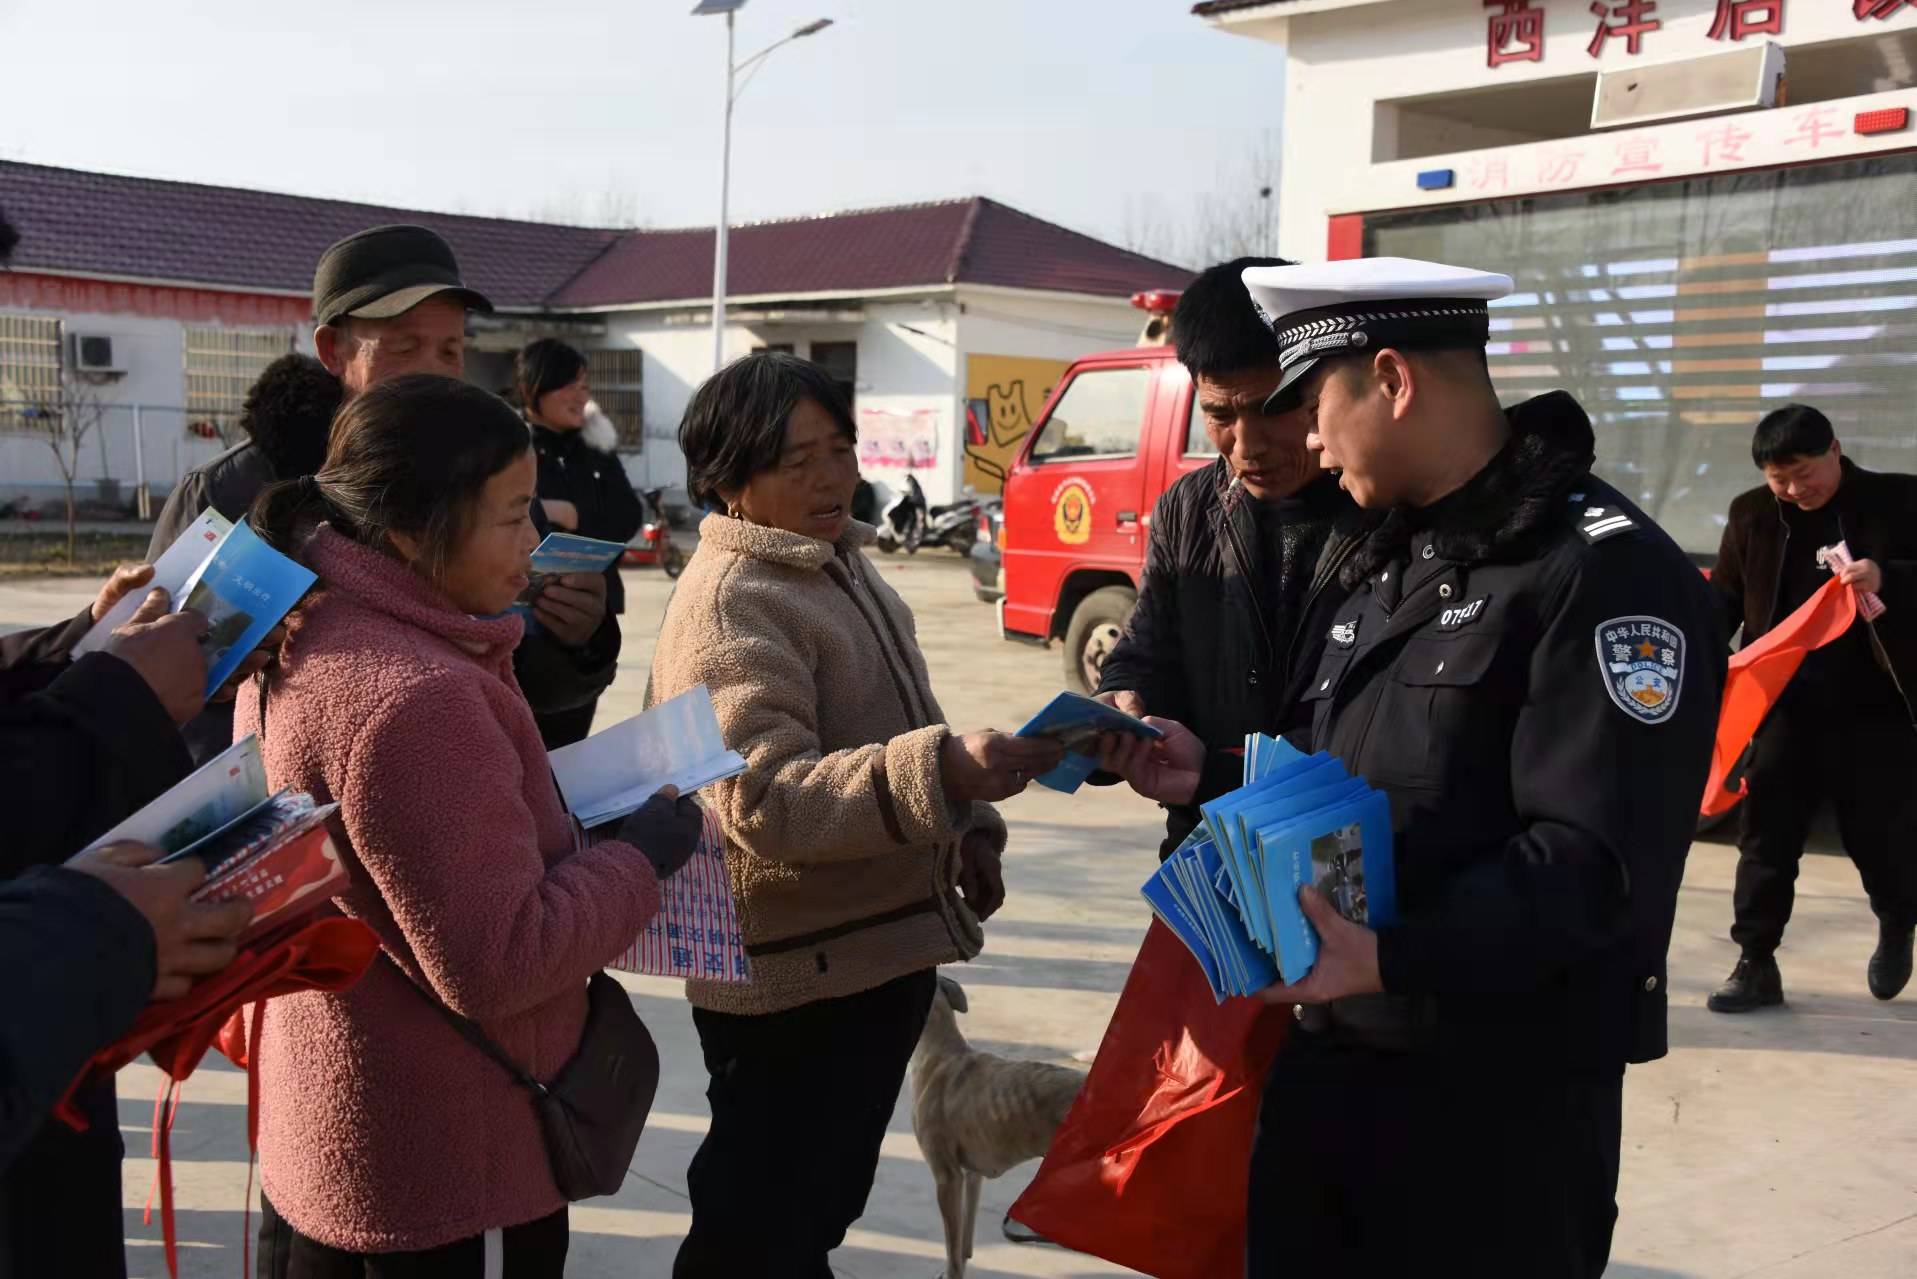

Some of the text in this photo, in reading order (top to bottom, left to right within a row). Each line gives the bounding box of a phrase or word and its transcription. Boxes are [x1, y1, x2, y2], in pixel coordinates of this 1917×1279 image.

[1470, 106, 1848, 190] 消防宣传车
[1605, 623, 1678, 649] 中华人民共和国
